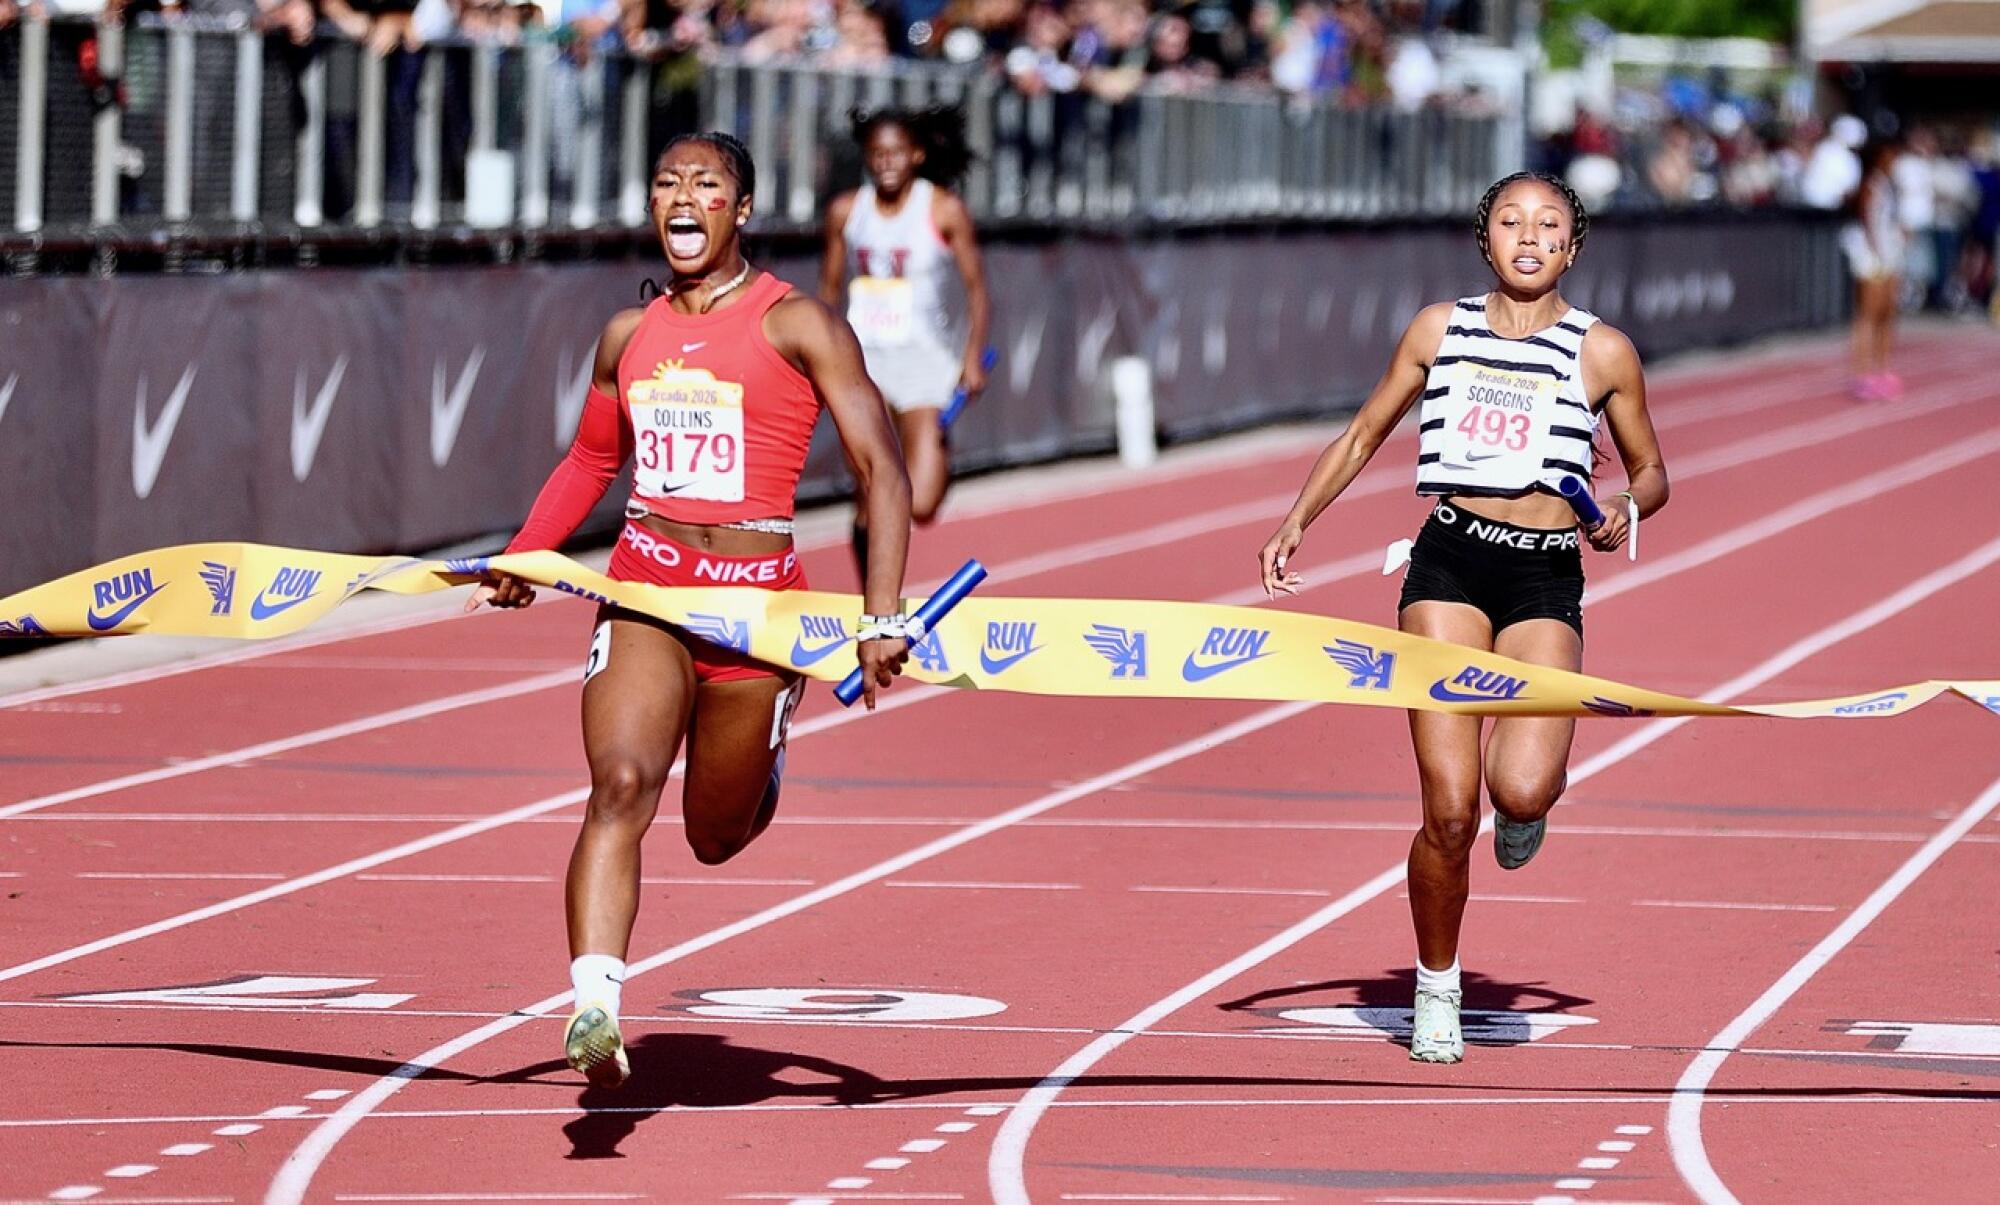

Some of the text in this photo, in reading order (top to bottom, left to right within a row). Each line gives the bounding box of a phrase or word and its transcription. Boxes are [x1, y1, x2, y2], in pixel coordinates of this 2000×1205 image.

[649, 388, 718, 405] Arcadia 2026
[1475, 370, 1539, 391] Arcadia 2026
[1467, 386, 1534, 412] SCOGGINS
[654, 408, 712, 428] COLLINS
[1457, 405, 1531, 451] 493
[641, 430, 736, 474] 3179
[1466, 519, 1540, 550] NIKE
[1541, 532, 1578, 551] PR
[623, 524, 681, 567] PRO
[694, 558, 779, 582] NIKE
[94, 568, 154, 609] RUN
[268, 566, 322, 598] RUN
[800, 615, 847, 641] RUN
[987, 621, 1037, 651] RUN
[1200, 626, 1270, 658] RUN
[1454, 665, 1528, 699] RUN
